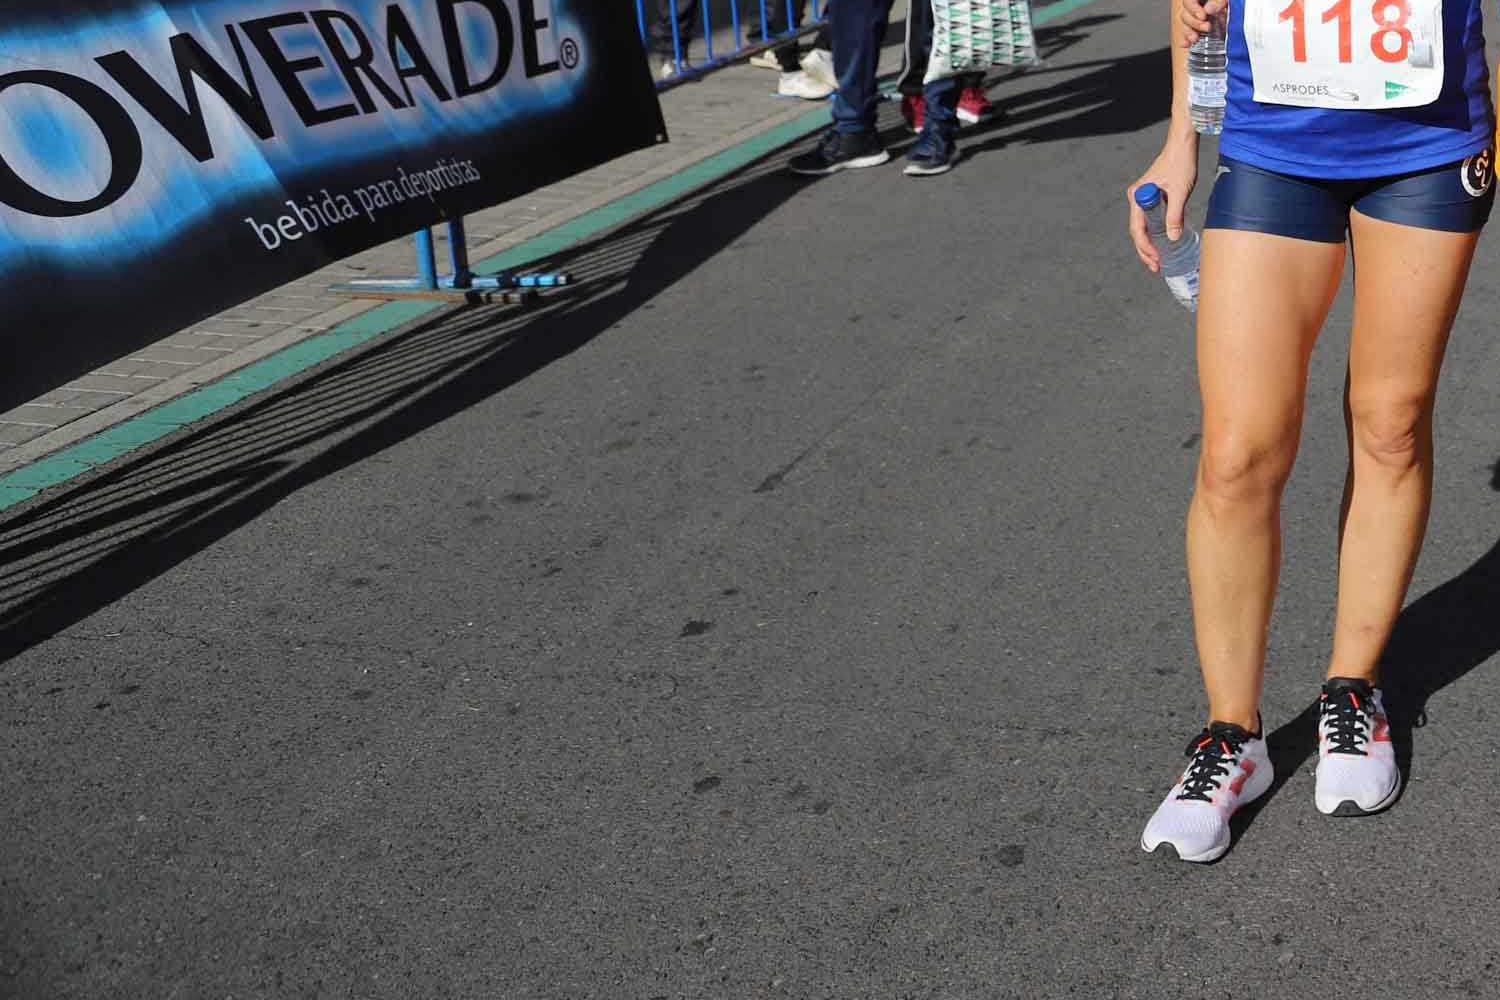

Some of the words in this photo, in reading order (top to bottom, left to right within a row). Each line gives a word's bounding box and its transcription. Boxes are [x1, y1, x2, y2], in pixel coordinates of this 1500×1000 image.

[1271, 82, 1329, 96] ASPRODES
[244, 188, 359, 251] bebida
[355, 178, 403, 223] para
[399, 157, 481, 203] deportistas
